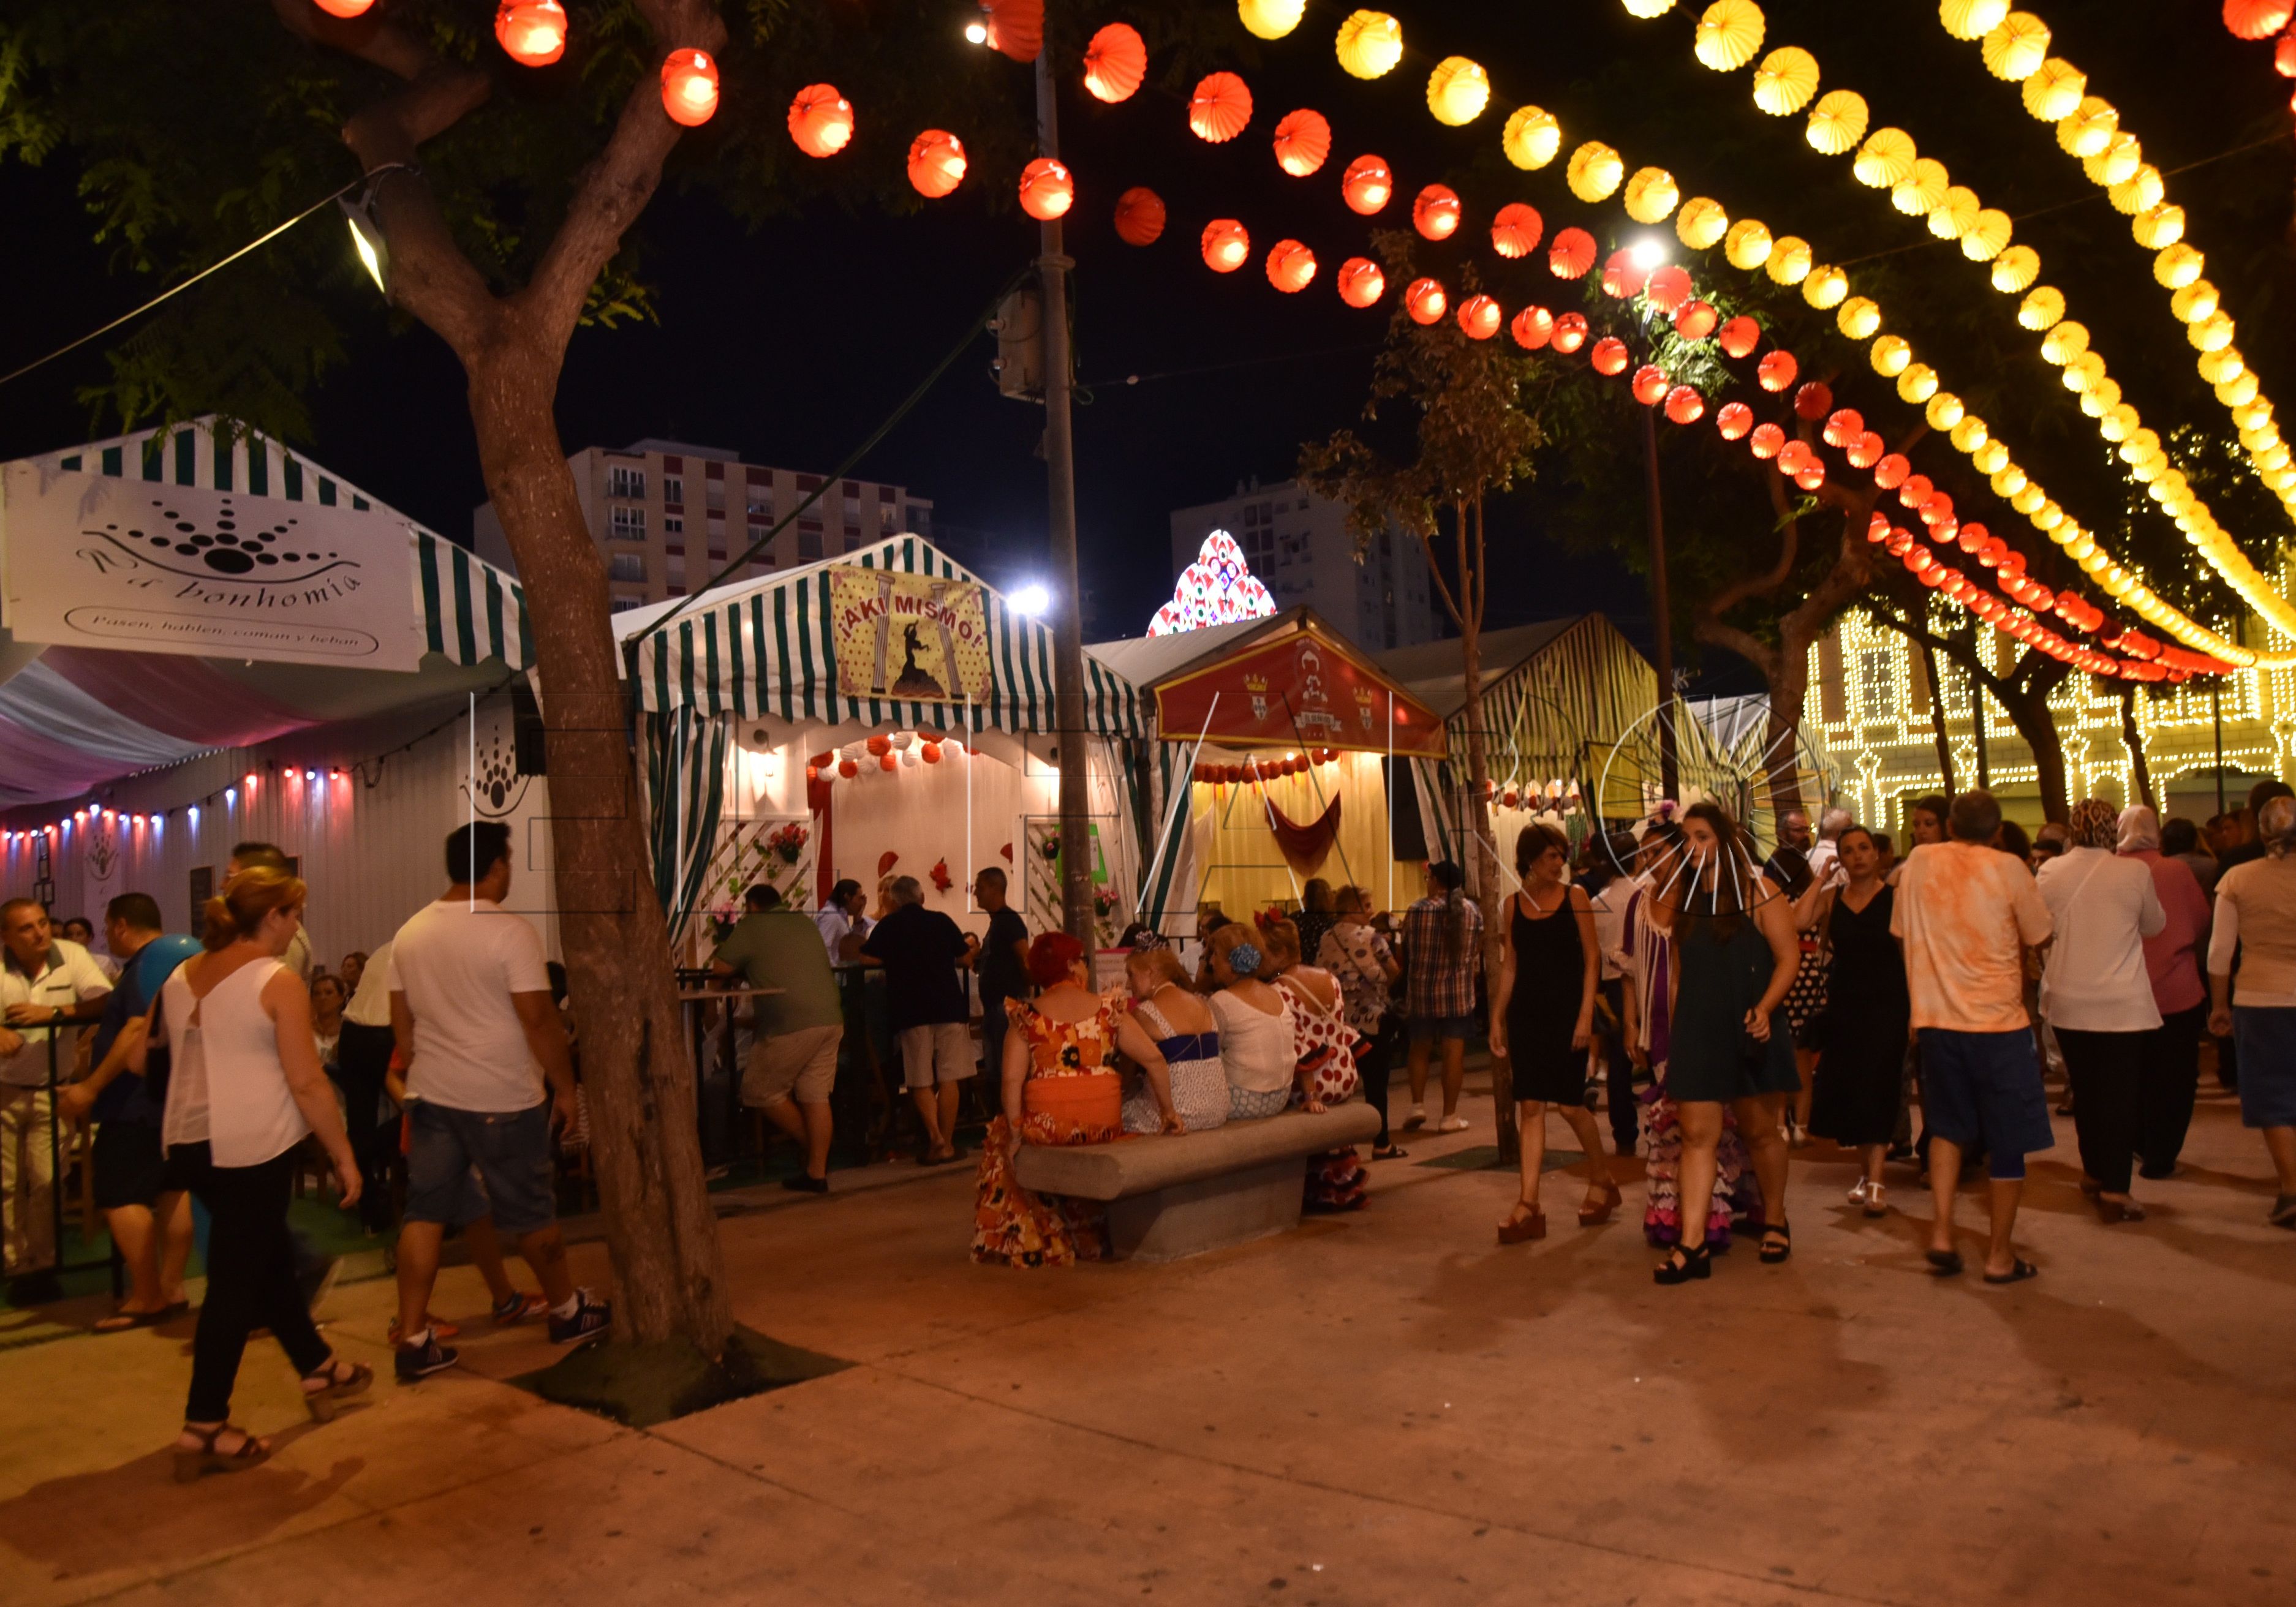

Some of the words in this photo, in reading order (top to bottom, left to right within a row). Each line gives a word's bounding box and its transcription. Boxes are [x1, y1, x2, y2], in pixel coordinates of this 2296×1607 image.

[233, 630, 290, 641] coman
[310, 634, 358, 647] beban
[894, 595, 983, 649] MISMO!
